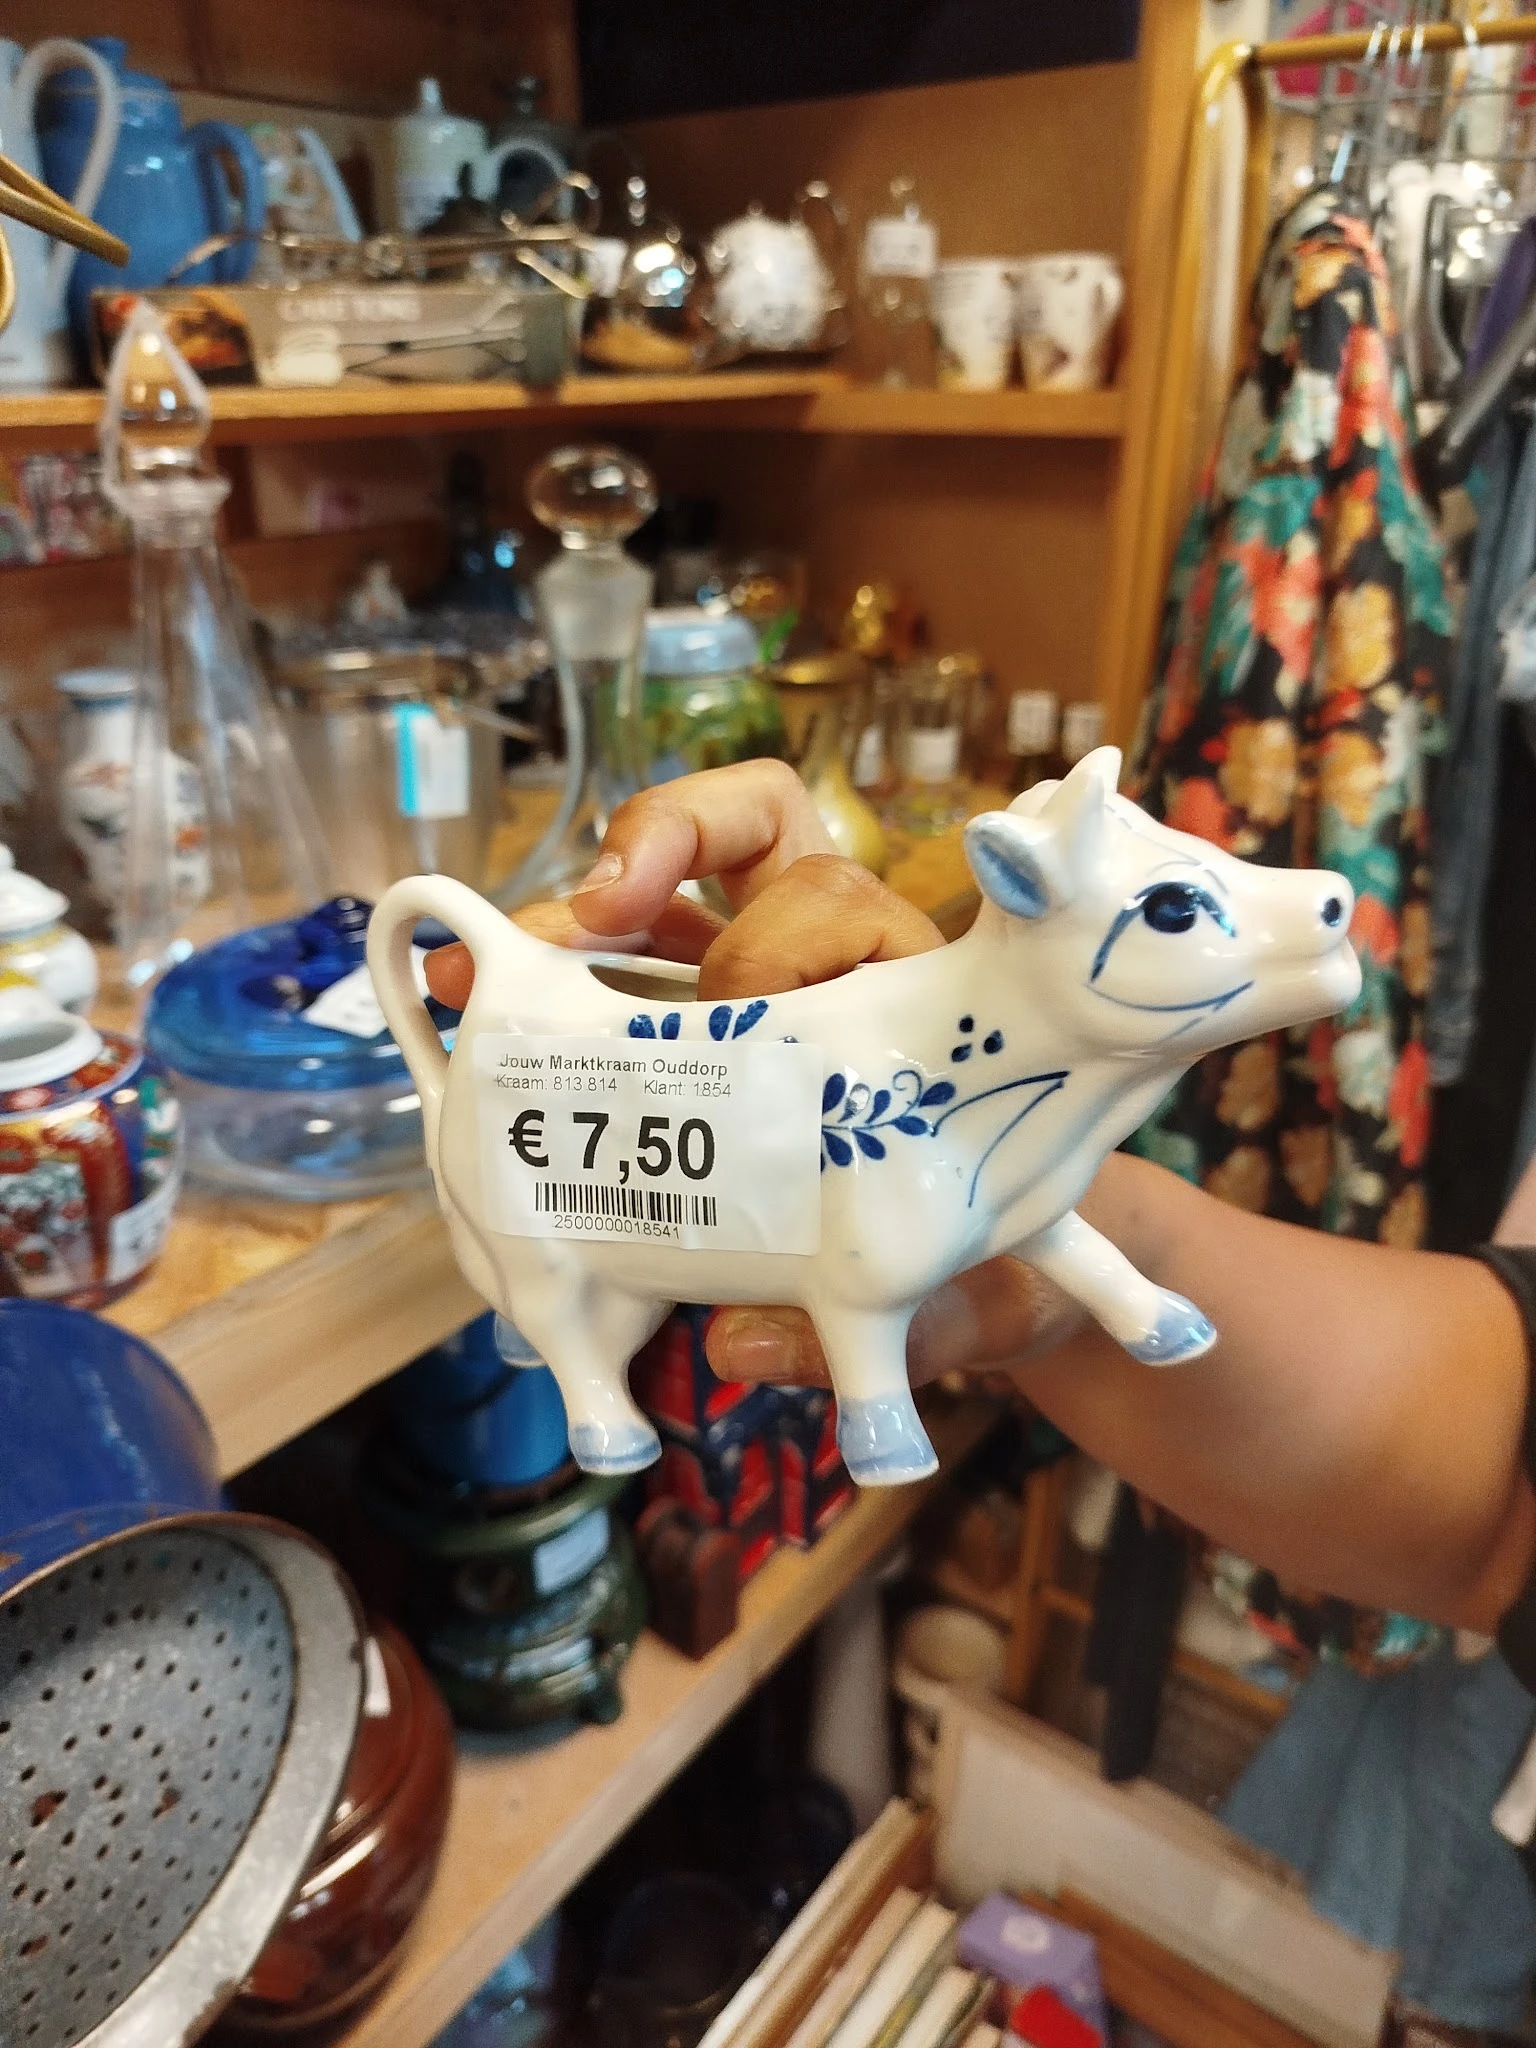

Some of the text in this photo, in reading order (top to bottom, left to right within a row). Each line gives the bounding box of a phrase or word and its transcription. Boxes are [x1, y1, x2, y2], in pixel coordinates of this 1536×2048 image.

[499, 1053, 728, 1080] Jouw Marktkraam Ouddorp
[495, 1074, 732, 1098] Kraam: 813 814 Klant: 1854
[508, 1109, 716, 1185] € 7,50
[553, 1214, 680, 1240] 2500000018541
